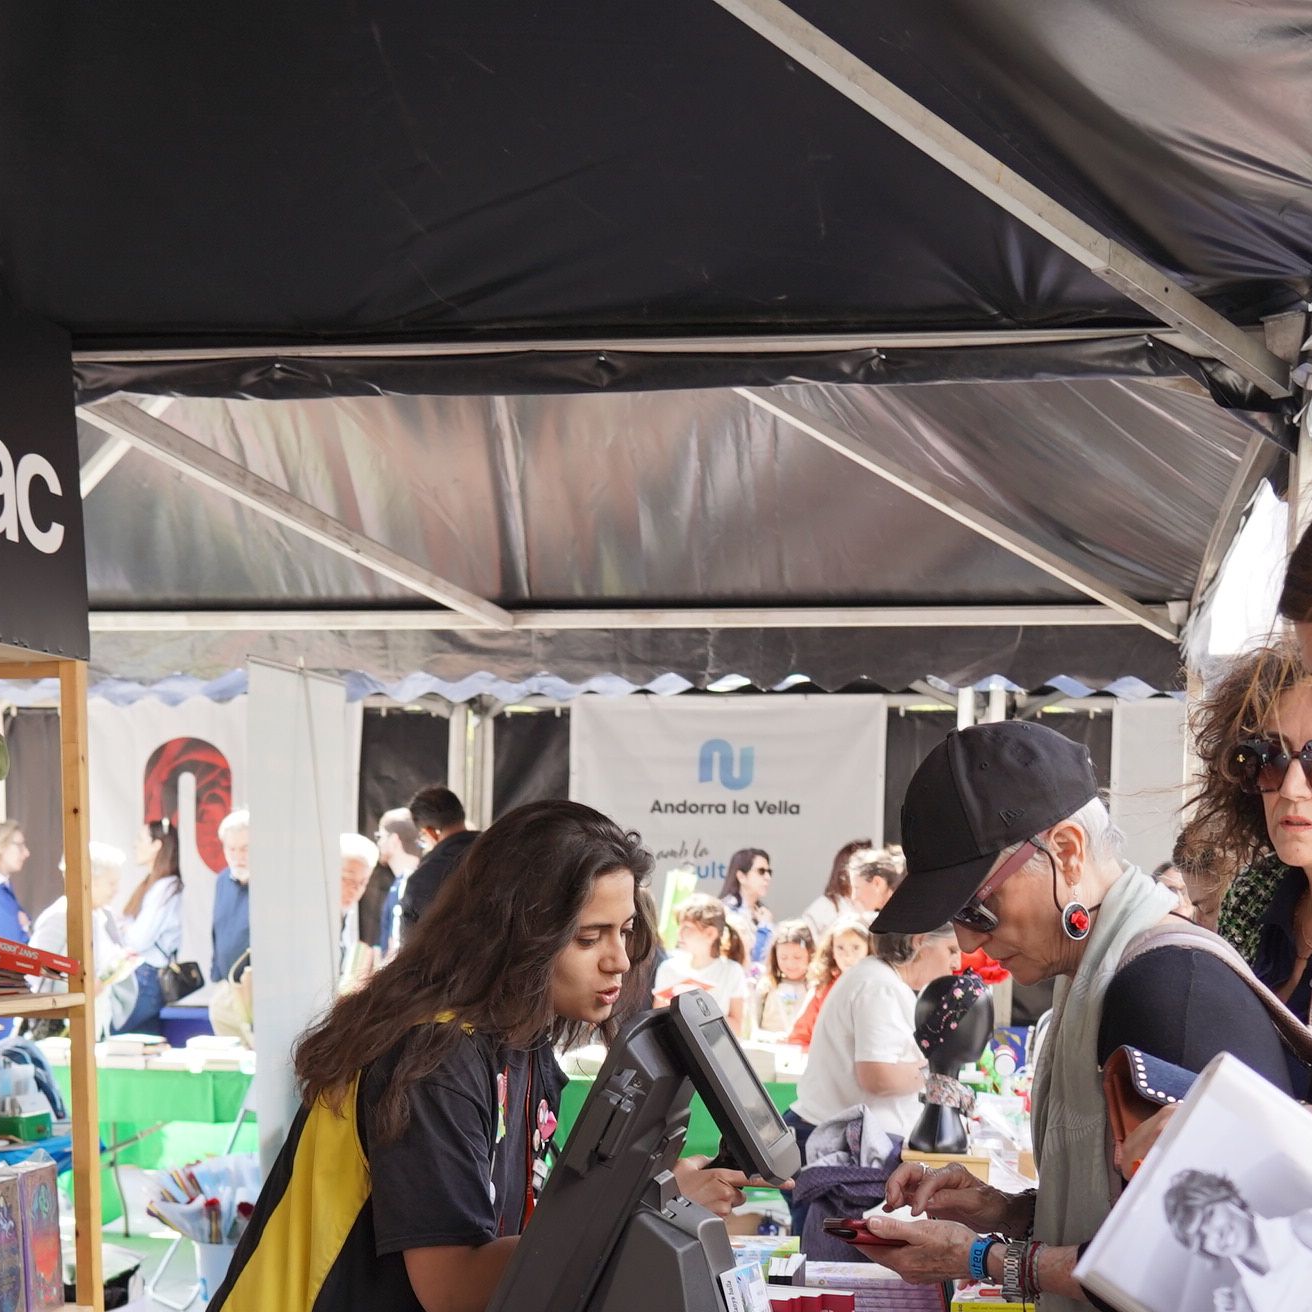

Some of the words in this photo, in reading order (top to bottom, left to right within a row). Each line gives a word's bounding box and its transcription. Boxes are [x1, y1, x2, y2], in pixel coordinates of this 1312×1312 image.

[650, 799, 726, 815] Andorra
[732, 799, 749, 815] la
[754, 800, 800, 815] Vella
